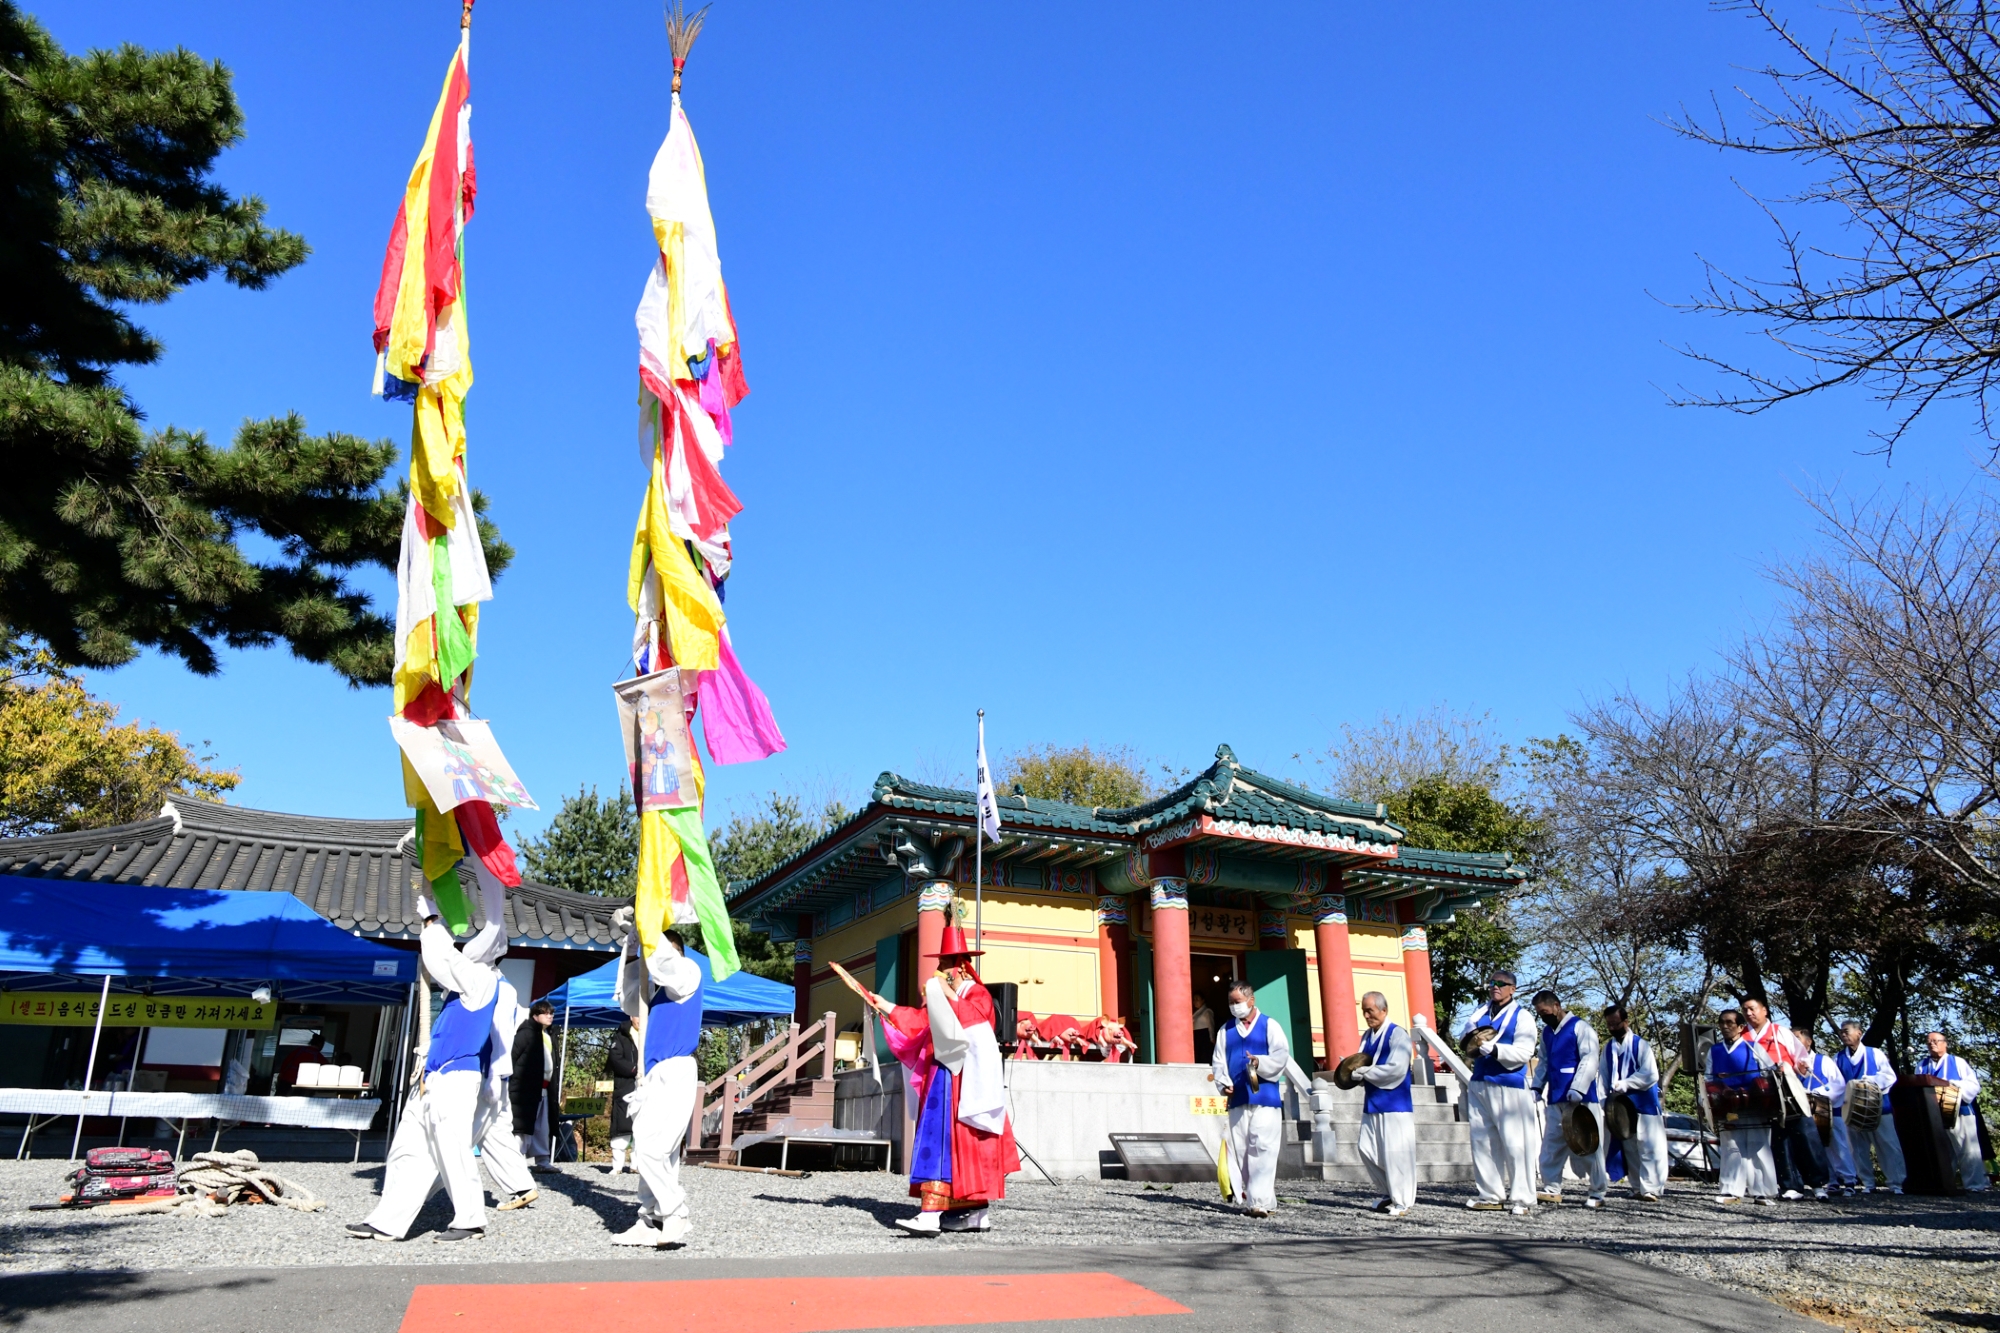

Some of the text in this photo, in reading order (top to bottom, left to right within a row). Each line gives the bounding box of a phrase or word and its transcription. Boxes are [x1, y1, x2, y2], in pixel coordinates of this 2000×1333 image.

[108, 1002, 137, 1018] 드실
[146, 1003, 187, 1020] 만큼만
[194, 1005, 264, 1021] 가져가세요
